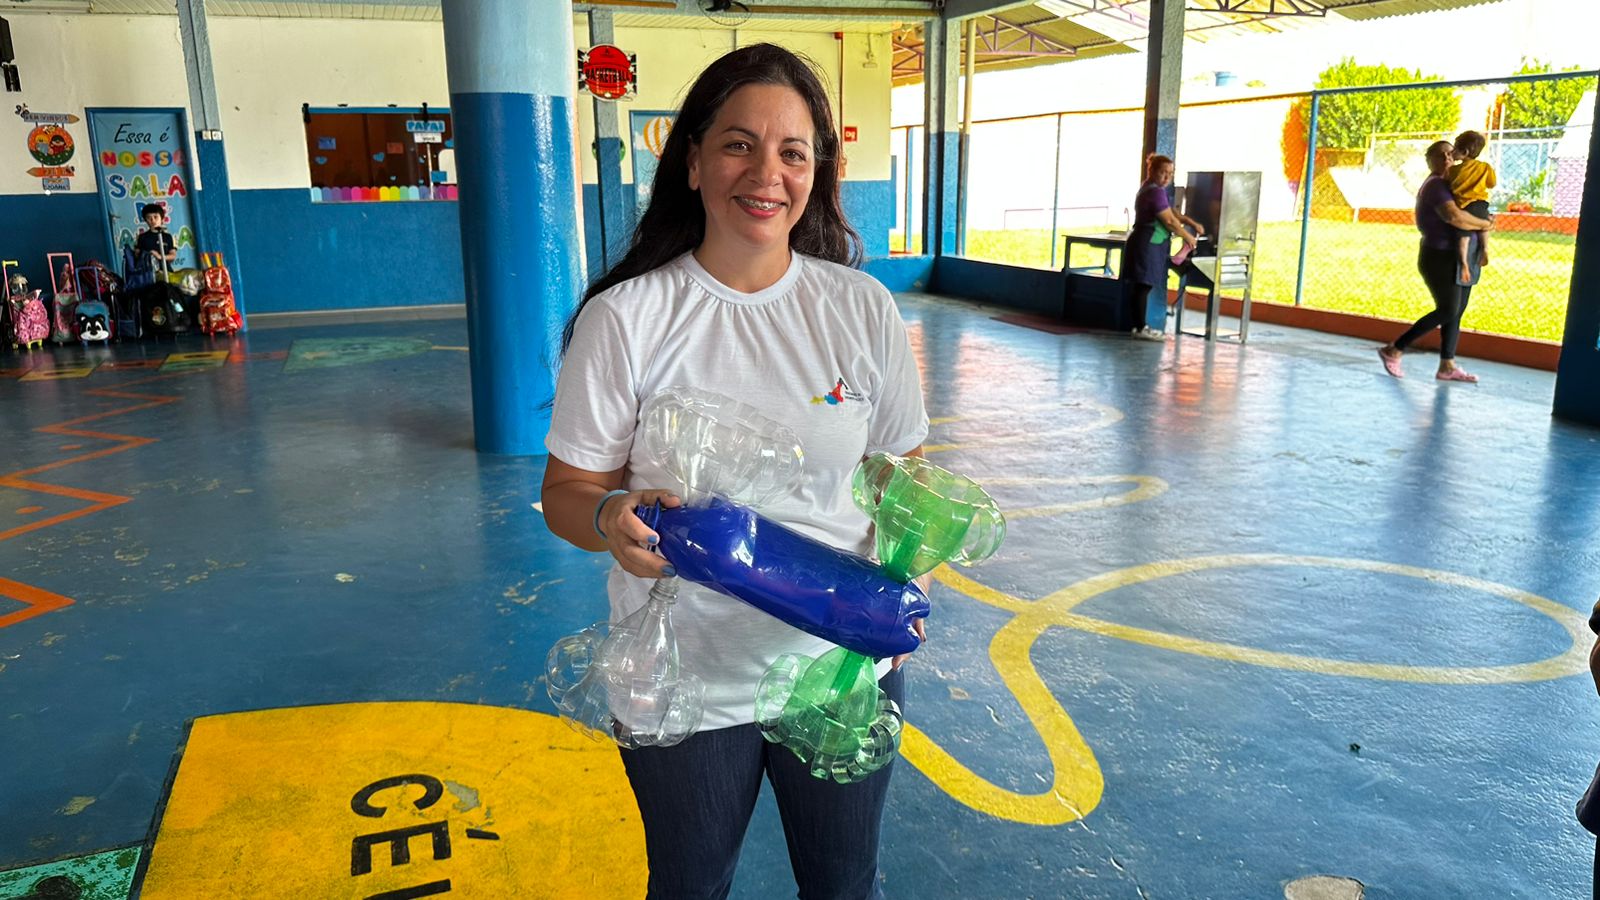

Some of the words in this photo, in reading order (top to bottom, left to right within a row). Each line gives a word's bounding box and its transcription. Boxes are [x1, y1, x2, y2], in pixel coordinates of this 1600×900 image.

[114, 123, 152, 144] Essa
[159, 126, 170, 142] é
[108, 173, 187, 198] SALA
